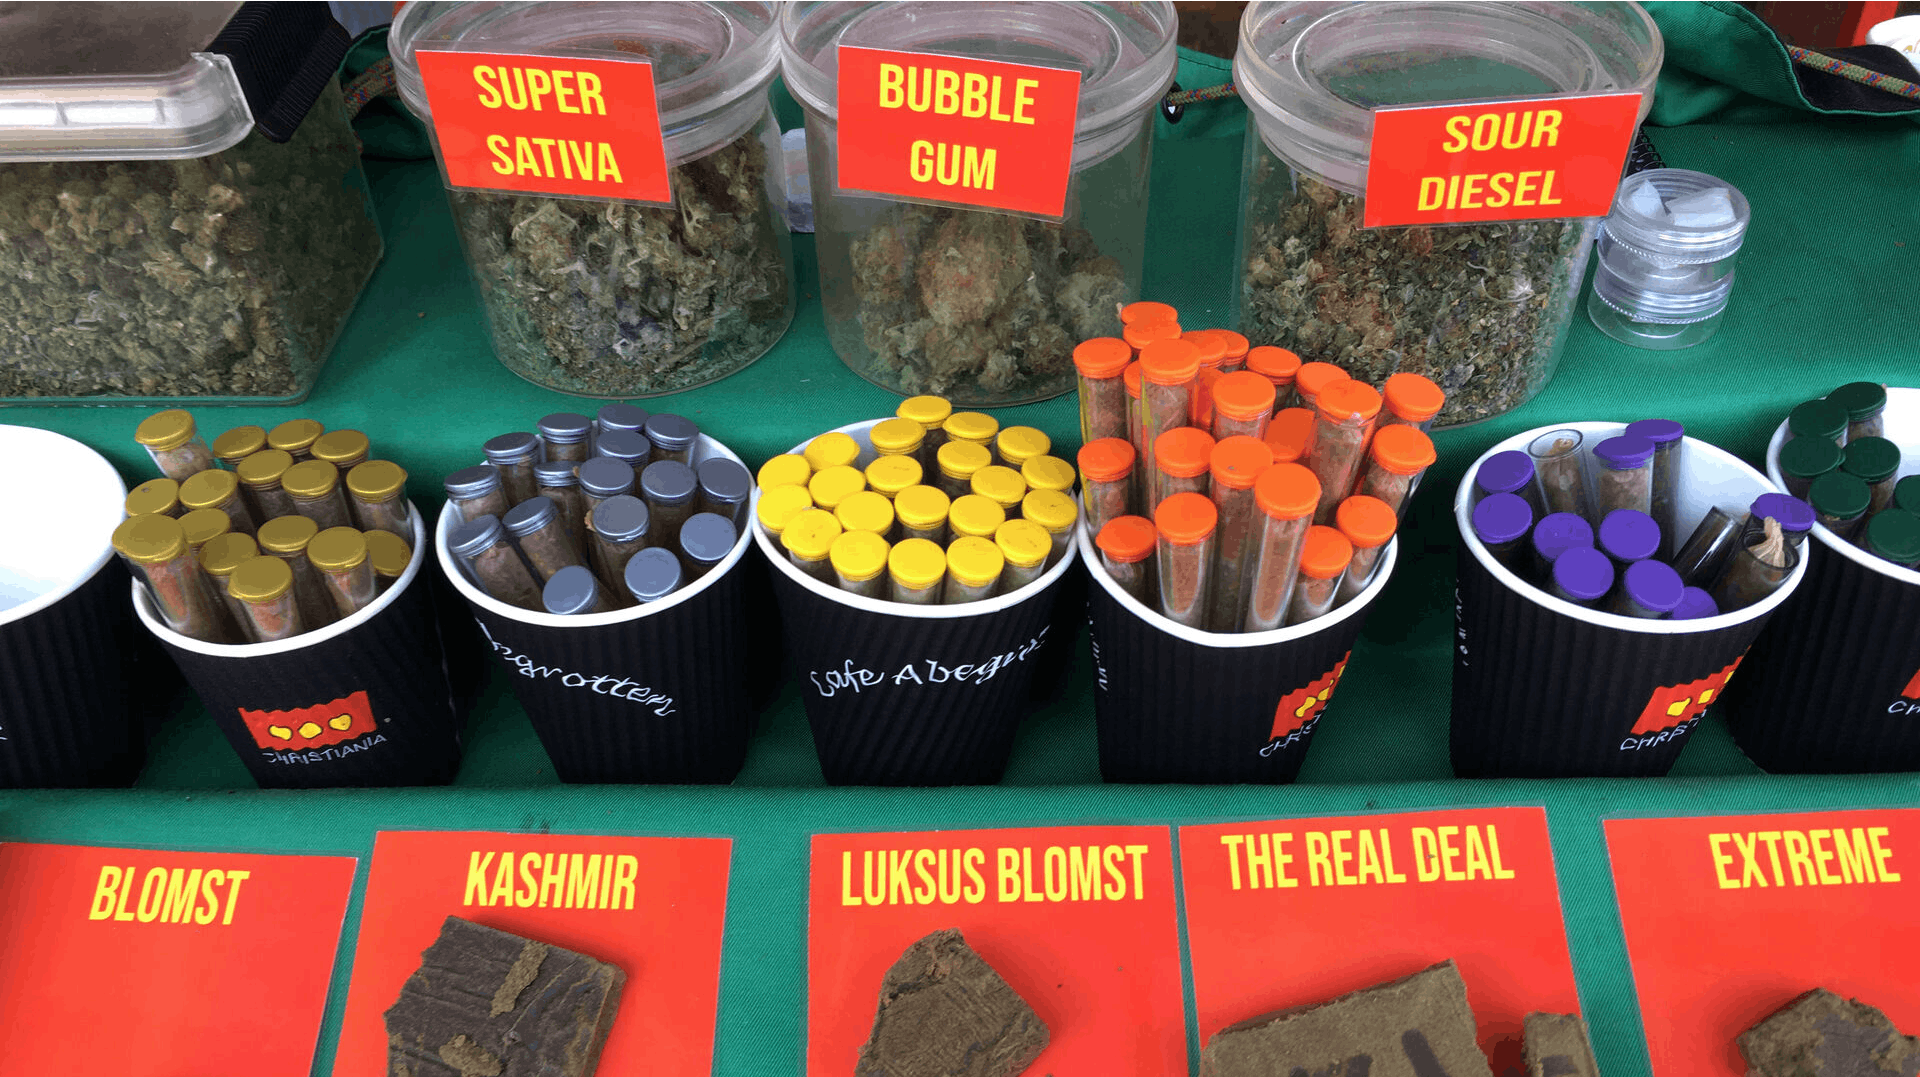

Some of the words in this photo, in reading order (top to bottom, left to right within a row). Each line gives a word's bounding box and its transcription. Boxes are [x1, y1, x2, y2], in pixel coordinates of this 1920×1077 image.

[472, 65, 607, 116] SUPER
[879, 62, 1039, 125] BUBBLE
[486, 134, 624, 184] SATIVA
[1442, 109, 1563, 153] SOUR
[909, 139, 997, 191] GUM
[1417, 169, 1562, 211] DIESEL
[262, 734, 387, 765] CHRISTIANIA
[463, 850, 639, 910] KASHMIR
[841, 847, 986, 907] LUKSUS
[997, 844, 1149, 903] BLOMST
[1220, 832, 1298, 890] THE
[1304, 828, 1407, 887] REAL
[1411, 824, 1516, 883] DEAL
[1708, 826, 1902, 890] EXTREME
[88, 865, 251, 926] BLOMST
